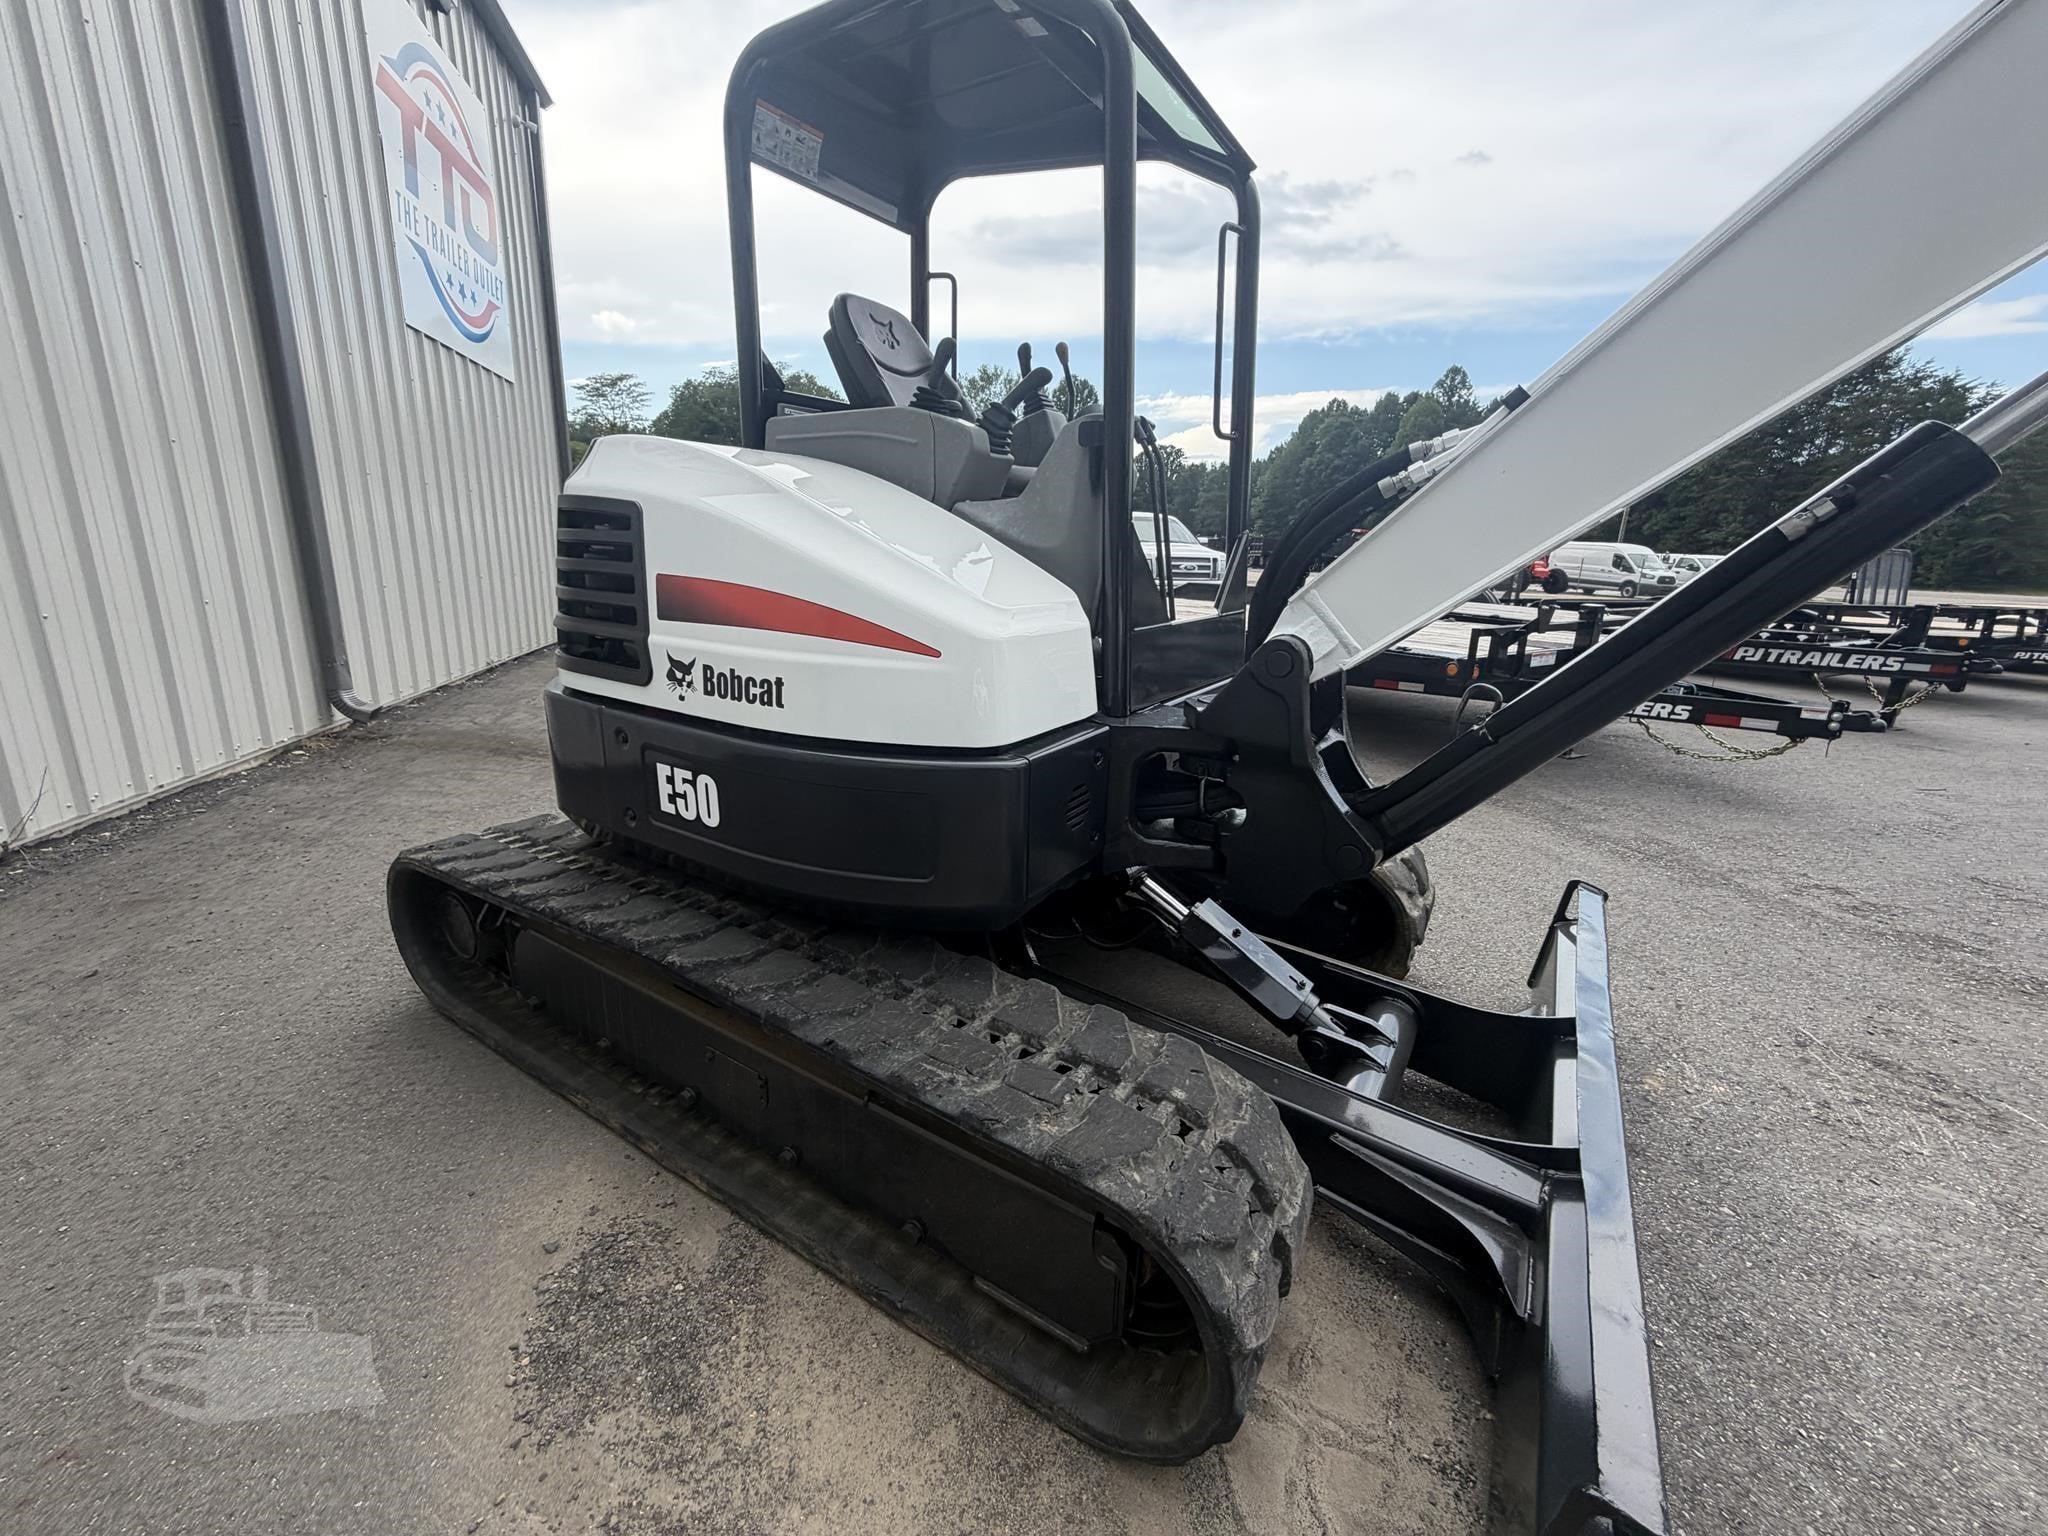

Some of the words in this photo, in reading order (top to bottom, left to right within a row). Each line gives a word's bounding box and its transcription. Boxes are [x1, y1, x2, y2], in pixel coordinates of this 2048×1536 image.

[395, 189, 420, 237] THE
[424, 214, 469, 277] TRAILER
[474, 257, 504, 304] OUTLET
[1733, 647, 1763, 661] PJ
[1766, 648, 1905, 672] TRAILERS
[702, 663, 785, 709] Bobcat
[1628, 701, 1693, 720] ERS
[656, 762, 720, 828] E50
